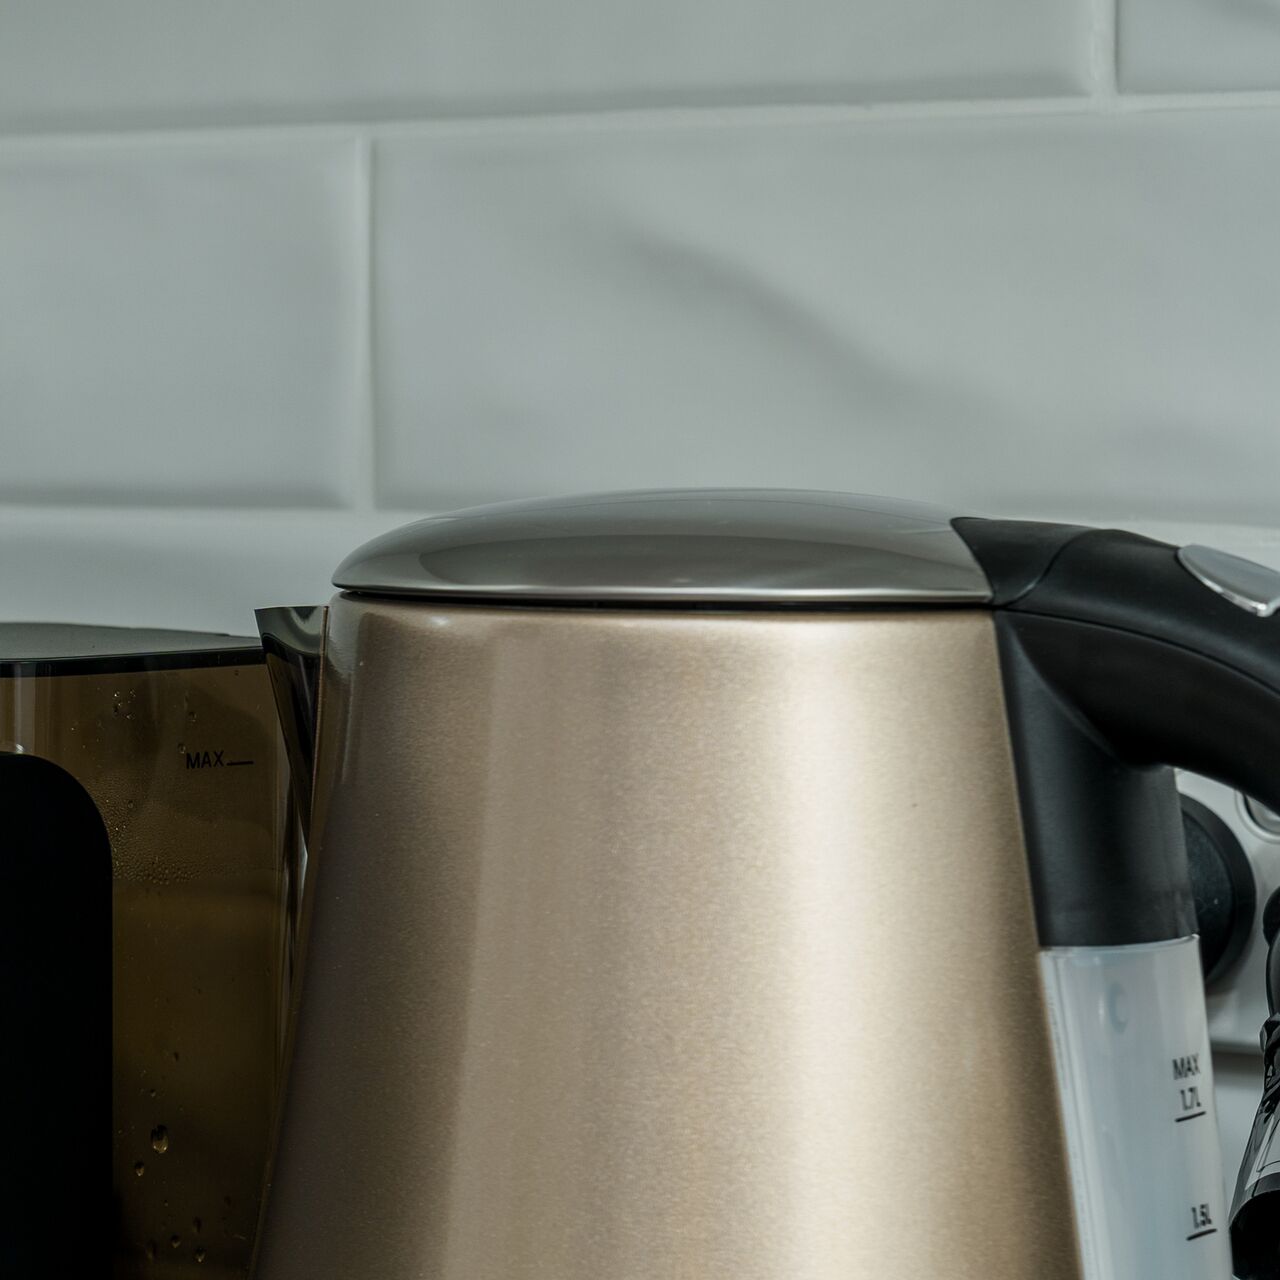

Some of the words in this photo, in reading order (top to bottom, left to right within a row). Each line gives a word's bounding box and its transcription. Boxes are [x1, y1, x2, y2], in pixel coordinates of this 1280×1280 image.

[186, 750, 224, 769] MAX
[1172, 1053, 1201, 1080] MAX
[1191, 1203, 1212, 1229] 1.5L
